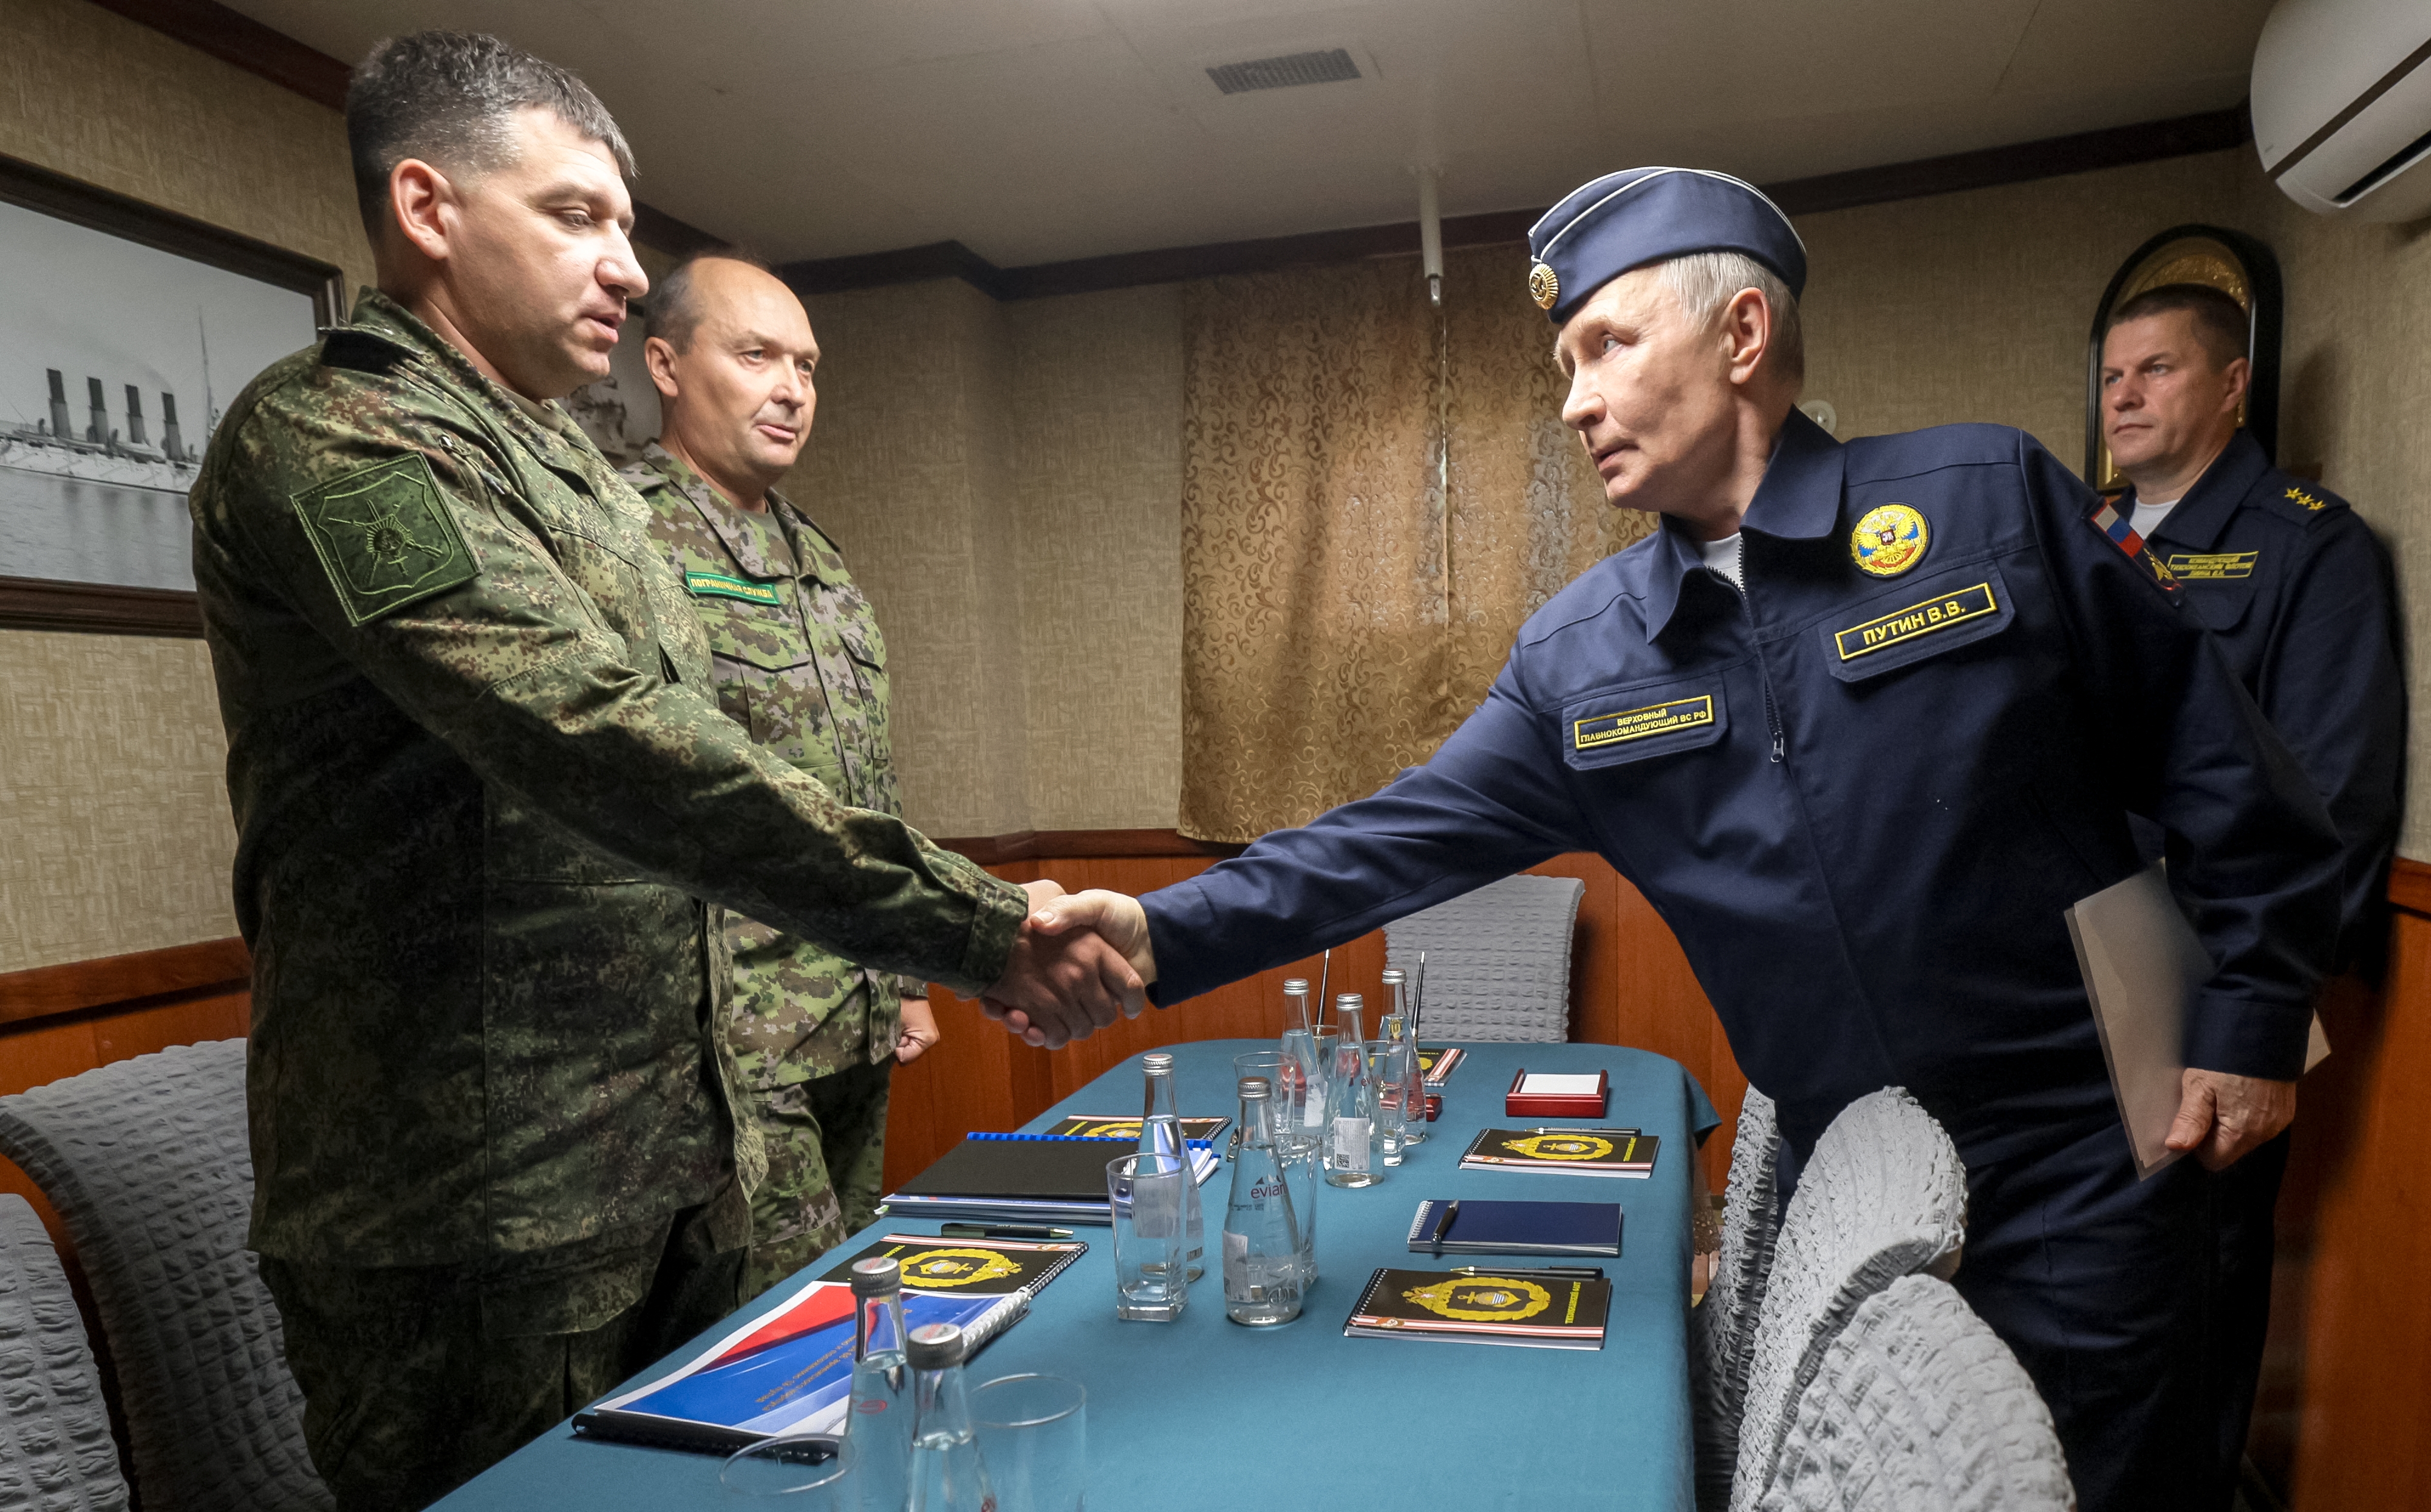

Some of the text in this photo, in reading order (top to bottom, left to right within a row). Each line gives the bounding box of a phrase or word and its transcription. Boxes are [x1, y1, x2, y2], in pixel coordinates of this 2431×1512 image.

[690, 578, 772, 598] ПОГРАНИЧНАЯ СЛУЖБА
[1863, 601, 1967, 645] ПУТИН В.В.
[1580, 710, 1707, 743] ГЛАВНОКОМАНДУЮЩИЙ ВС РФ
[1617, 708, 1668, 726] ВЕРХОВНЫЙ
[1250, 1183, 1286, 1199] evian
